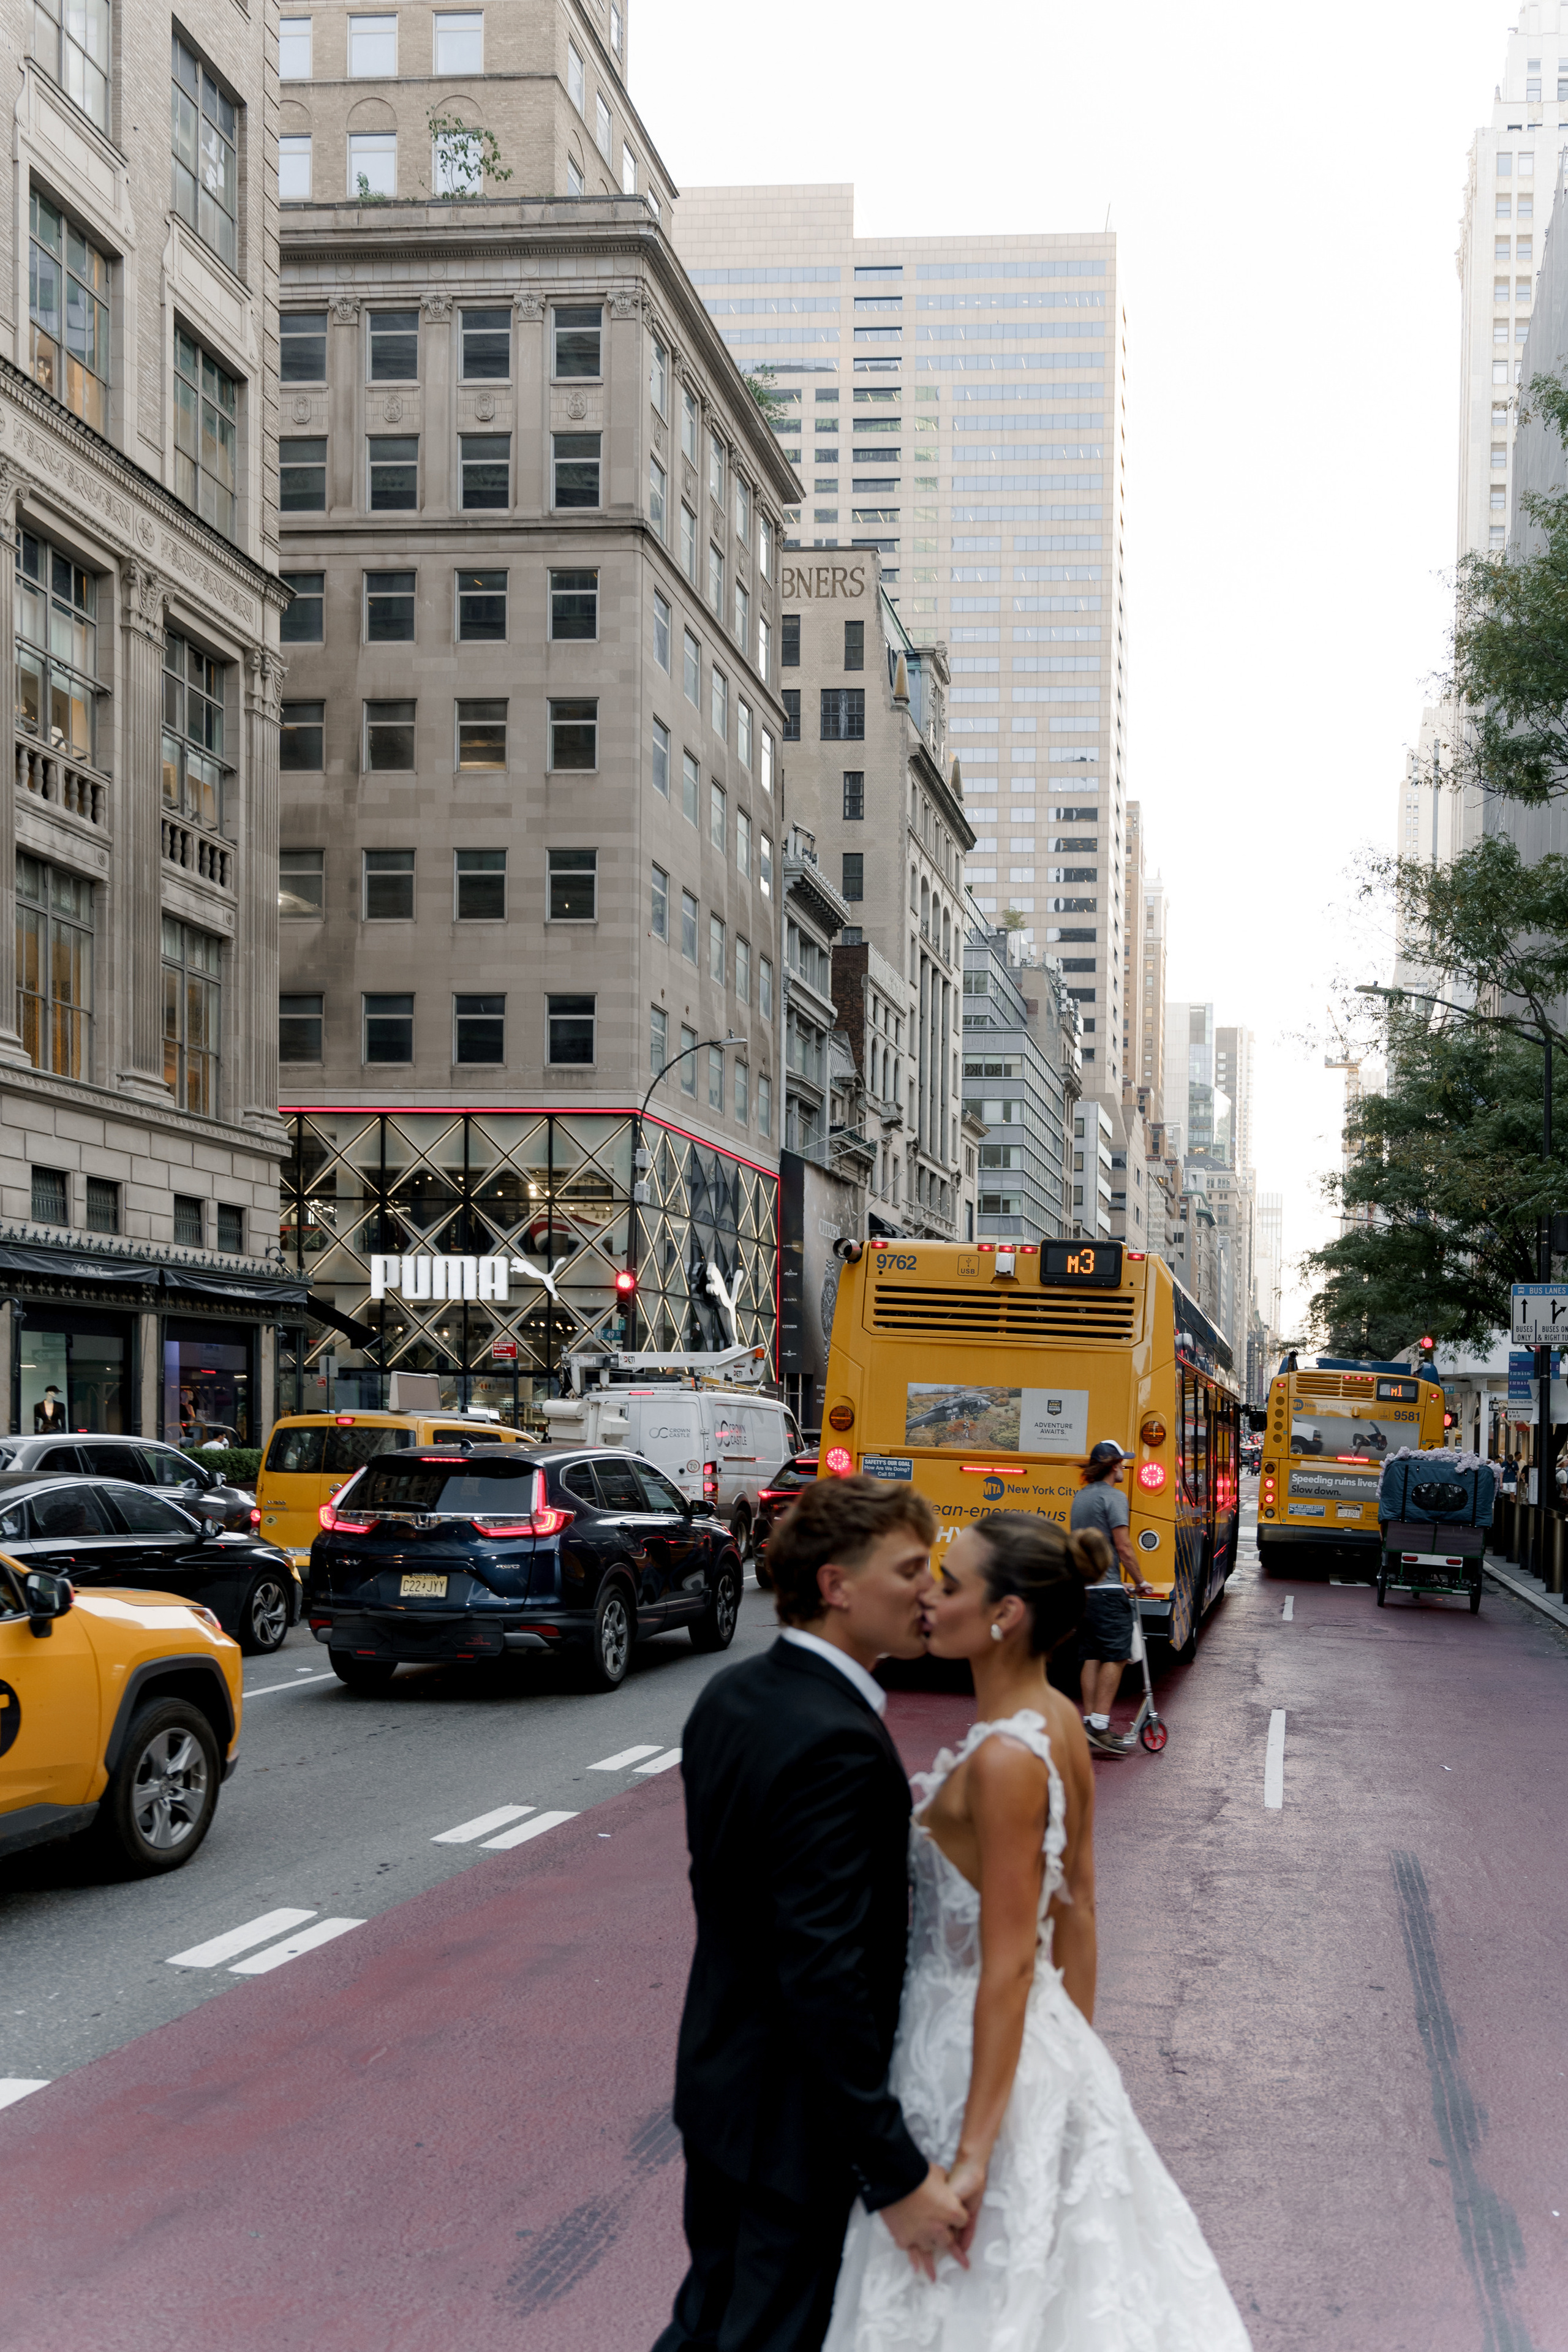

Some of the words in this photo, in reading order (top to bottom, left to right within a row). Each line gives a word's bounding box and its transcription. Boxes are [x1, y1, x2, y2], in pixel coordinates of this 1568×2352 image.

[782, 567, 865, 598] BNERS
[876, 1253, 917, 1270] 9762
[1067, 1249, 1095, 1274] M3
[371, 1254, 509, 1300] PUMA
[601, 1330, 605, 1339] E
[606, 1330, 615, 1339] 49
[1390, 1384, 1403, 1396] M1
[1394, 1410, 1420, 1422] 9581
[728, 1423, 746, 1434] CROWN
[730, 1435, 747, 1446] CASTLE
[1291, 1473, 1333, 1487] Speeding
[1334, 1477, 1357, 1486] ruins
[1357, 1478, 1378, 1488] lives.
[982, 1482, 1001, 1496] MTA
[1007, 1484, 1030, 1494] New
[1032, 1485, 1055, 1496] York
[1057, 1487, 1079, 1498] City
[1291, 1485, 1313, 1494] Slow
[1314, 1486, 1341, 1496] down.
[1036, 1507, 1067, 1521] bus
[402, 1580, 421, 1592] C22
[426, 1580, 445, 1593] JYY
